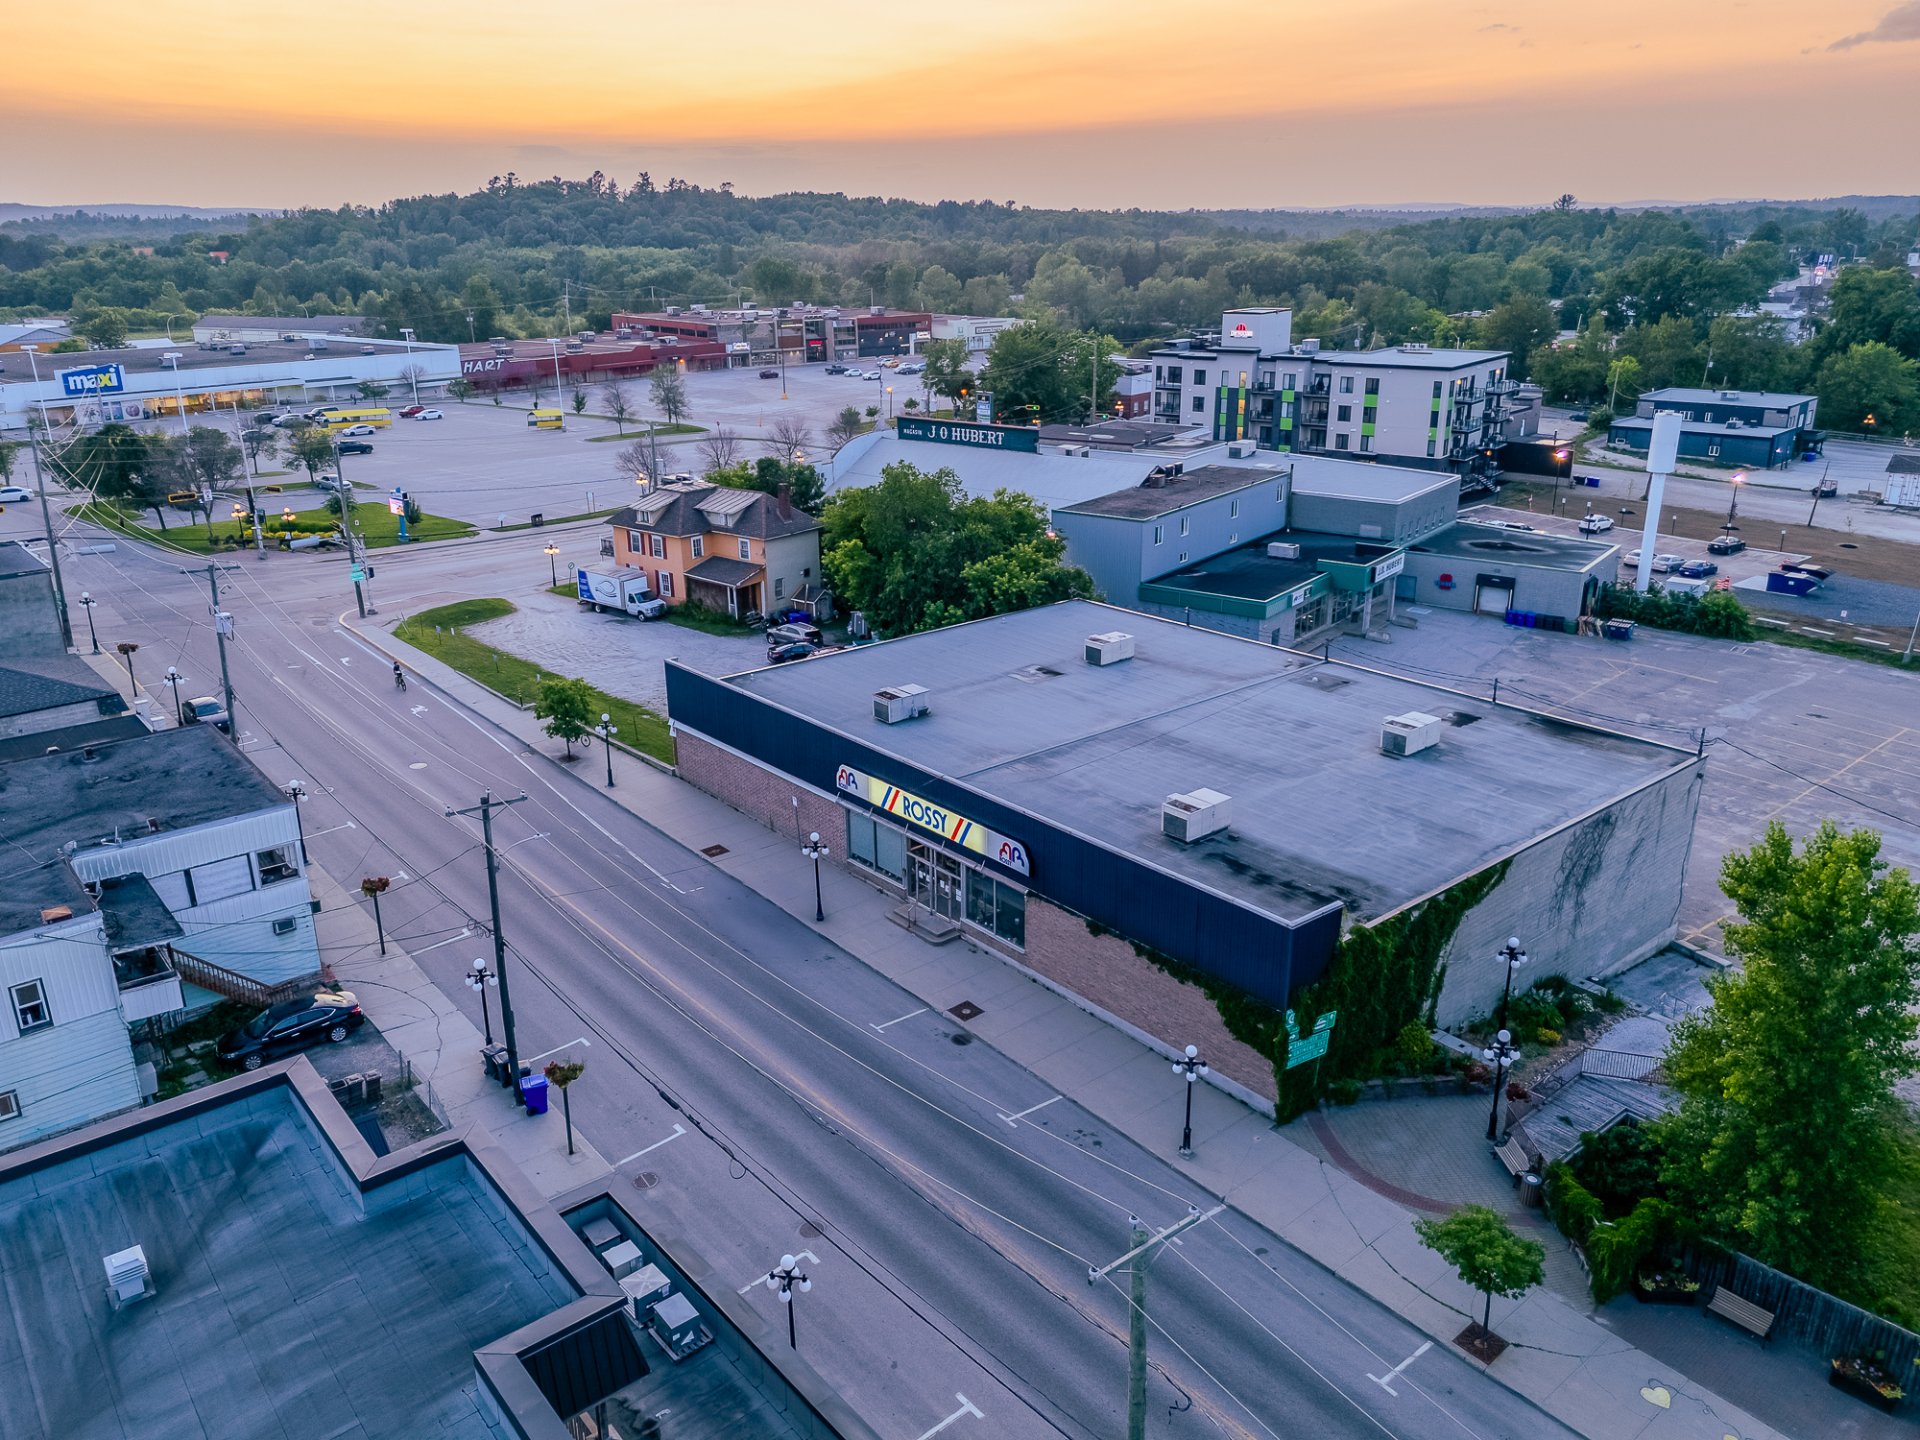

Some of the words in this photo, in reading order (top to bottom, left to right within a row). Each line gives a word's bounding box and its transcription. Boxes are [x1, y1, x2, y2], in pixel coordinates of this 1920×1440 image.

[463, 359, 504, 373] HART
[67, 367, 118, 390] maxi
[951, 427, 1005, 445] HUBERT
[903, 795, 947, 833] ROSSY
